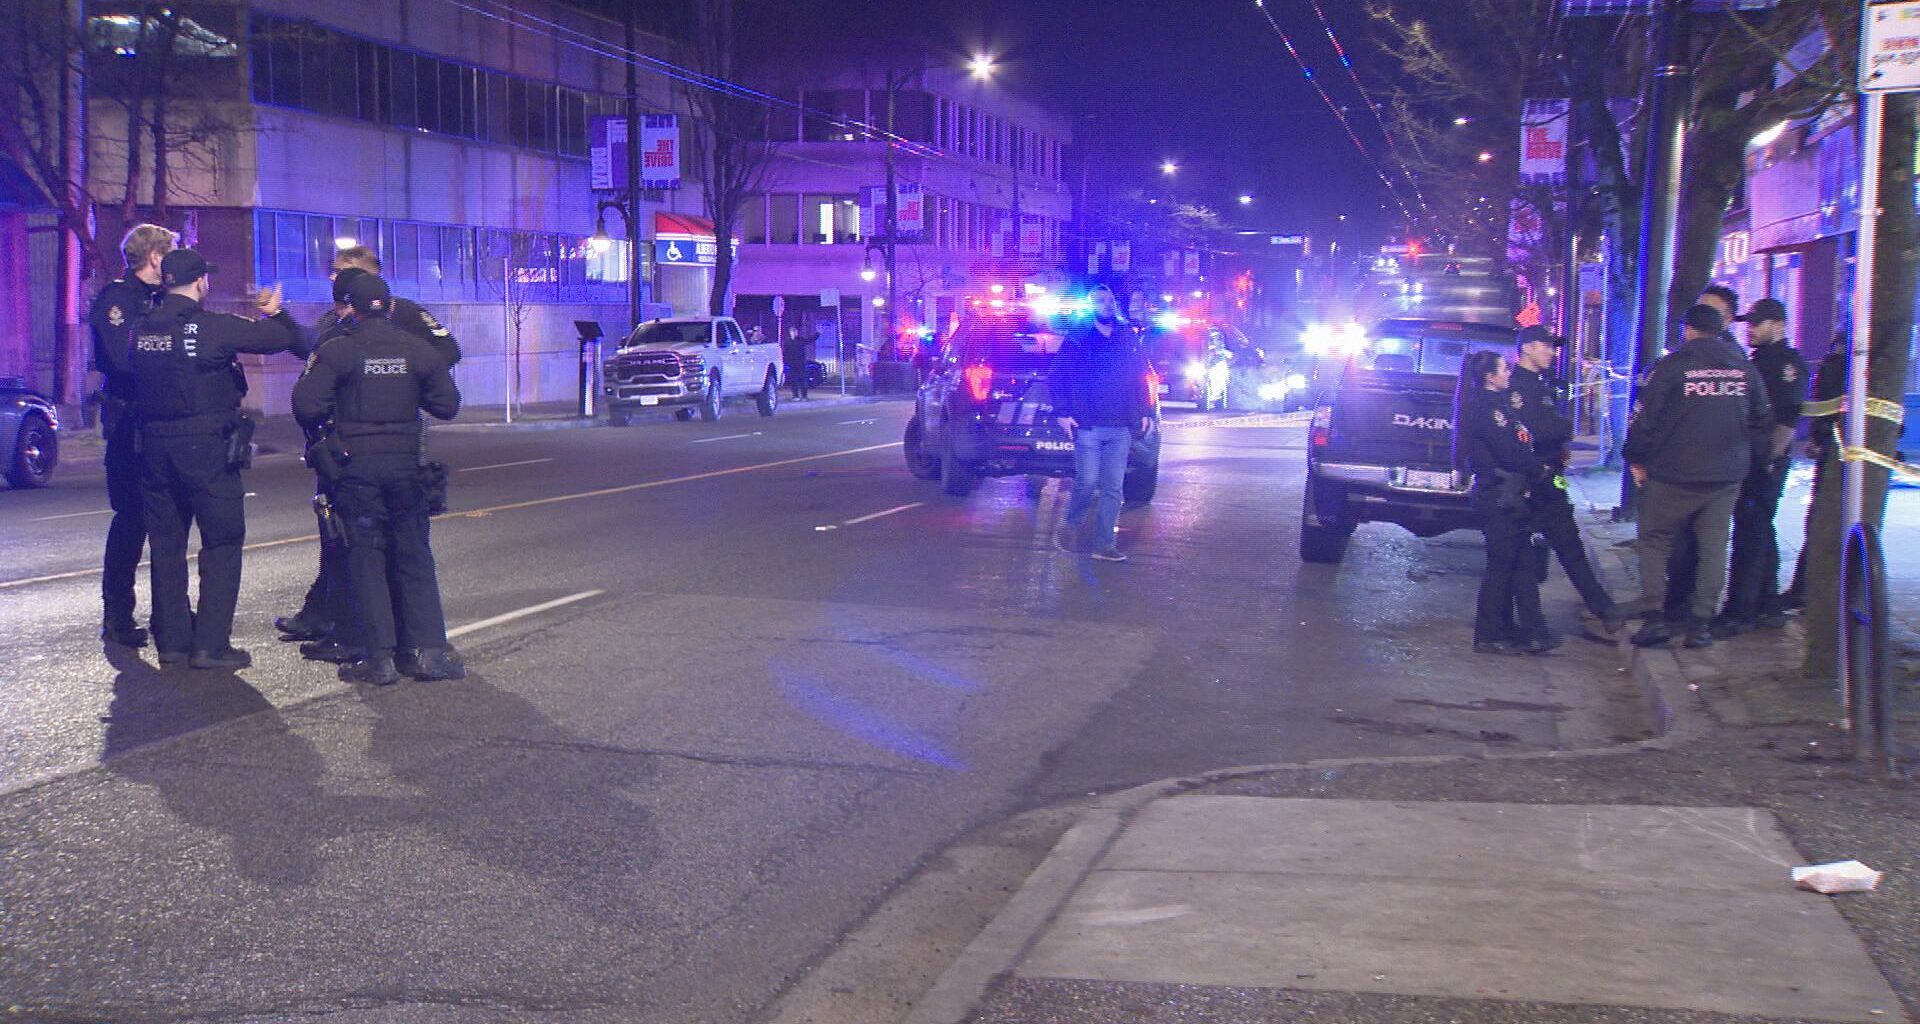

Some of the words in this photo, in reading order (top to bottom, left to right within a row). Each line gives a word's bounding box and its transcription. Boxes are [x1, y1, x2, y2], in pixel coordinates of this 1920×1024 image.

[1527, 128, 1549, 142] THE
[1526, 142, 1562, 159] DRIVE
[137, 341, 172, 351] POLICE
[364, 364, 408, 375] POLICE
[1683, 369, 1746, 378] VANCOUVER
[1683, 382, 1747, 396] POLICE
[1392, 414, 1456, 430] DAKIN
[1036, 441, 1074, 451] POLIC
